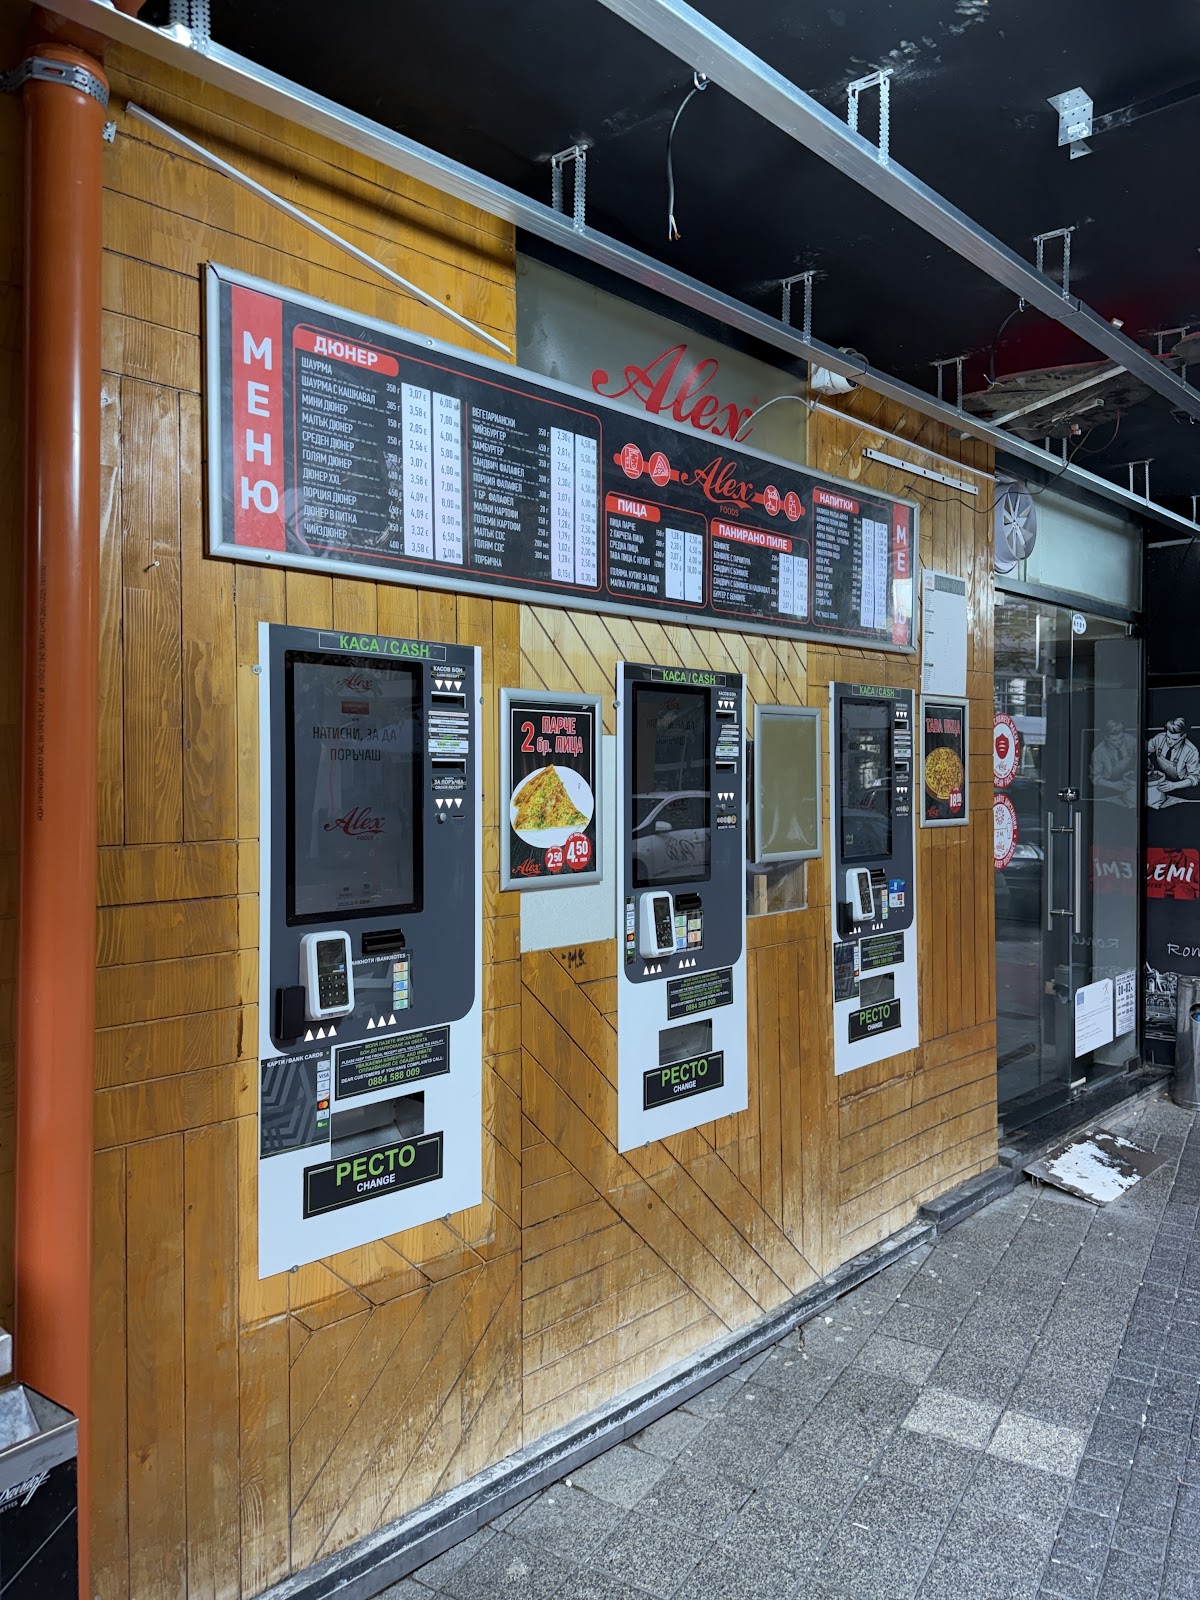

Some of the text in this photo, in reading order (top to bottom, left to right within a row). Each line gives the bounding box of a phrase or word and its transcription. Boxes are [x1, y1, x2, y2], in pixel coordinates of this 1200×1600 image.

[314, 336, 378, 366] ДЮНЕР
[302, 356, 332, 375] ШАУРМА
[302, 376, 332, 392] ШАУРМА
[338, 386, 376, 404] КАШКАВАЛ
[409, 388, 422, 400] 3,07
[592, 344, 753, 442] Alex
[302, 394, 348, 415] МИНИ ДЮНЕР
[410, 406, 422, 418] 3,58
[440, 398, 452, 409] 6,00
[240, 330, 278, 514] МЕНЮ
[302, 412, 354, 434] МАЛЪК ДЮНЕР
[440, 414, 452, 426] 7,00
[472, 406, 516, 428] ВЕГЕТАРИАНСКИ
[410, 423, 422, 435] 2,05
[440, 430, 452, 442] 4,00
[472, 423, 506, 440] ЧИЙЗБУРГЕР
[302, 431, 354, 452] СРЕДЕН ДЮНЕР
[410, 440, 423, 452] 2,56
[472, 440, 504, 456] ХАМБУРГЕР
[303, 449, 352, 469] ГОЛЯМ ДЮНЕР
[410, 456, 423, 468] 3,07
[440, 448, 453, 459] 5,00
[440, 465, 454, 476] 6,00
[472, 456, 524, 478] САНДВИЧ ФАЛАФЕЛ
[303, 467, 341, 486] ДЮНЕР XXL
[410, 474, 424, 485] 3,58
[473, 473, 522, 492] ПОРЦИЯ ФАЛАФЕЛ
[681, 456, 754, 510] Alex
[441, 481, 454, 492] 7,00
[304, 486, 357, 506] ПОРЦИЯ ДЮНЕР
[410, 490, 424, 502] 4,09
[442, 498, 454, 508] 8,00
[820, 493, 853, 511] НАПИТКИ
[304, 504, 329, 518] ДЮНЕР
[335, 510, 358, 524] ПИТКА
[411, 508, 424, 519] 4,09
[618, 500, 648, 517] ПИЦА
[720, 506, 739, 517] FOODS
[442, 514, 454, 525] 8,00
[304, 522, 348, 540] ЧИЙЗДЮНЕР
[411, 525, 424, 536] 3,32
[442, 531, 454, 542] 6,50
[496, 530, 506, 540] СОС
[719, 524, 788, 551] ПАНИРАНО ПИЛЕ
[412, 542, 424, 553] 3,58
[474, 539, 504, 552] ГОЛЯМ СОС
[474, 554, 502, 568] ТОРБИЧКА
[340, 635, 380, 652] КАСА
[336, 672, 374, 691] Alex
[663, 670, 686, 682] КАСА
[860, 686, 874, 696] КАСА
[542, 716, 576, 734] ПАРЧЕ
[926, 718, 942, 734] ТАВА
[312, 726, 396, 742] НАТИСНИ, ЗА ДА
[521, 721, 583, 757] 2 бр. ПИЦА
[330, 748, 381, 762] ПОРЪЧАШ
[324, 806, 386, 836] Alex
[512, 858, 542, 876] Alex
[860, 1004, 890, 1026] РЕСТО
[867, 1020, 884, 1031] CHANGE
[267, 1060, 285, 1068] КАРТИ
[304, 1052, 324, 1060] CARDS
[354, 1070, 380, 1081] CUSTOMERS
[407, 1058, 432, 1068] COMPLAINTS
[368, 1067, 420, 1087] 0884 588 009
[661, 1058, 708, 1086] РЕСТО
[674, 1080, 696, 1093] CHANGE
[336, 1144, 416, 1186] РЕСТО
[356, 1174, 396, 1192] CHANGE
